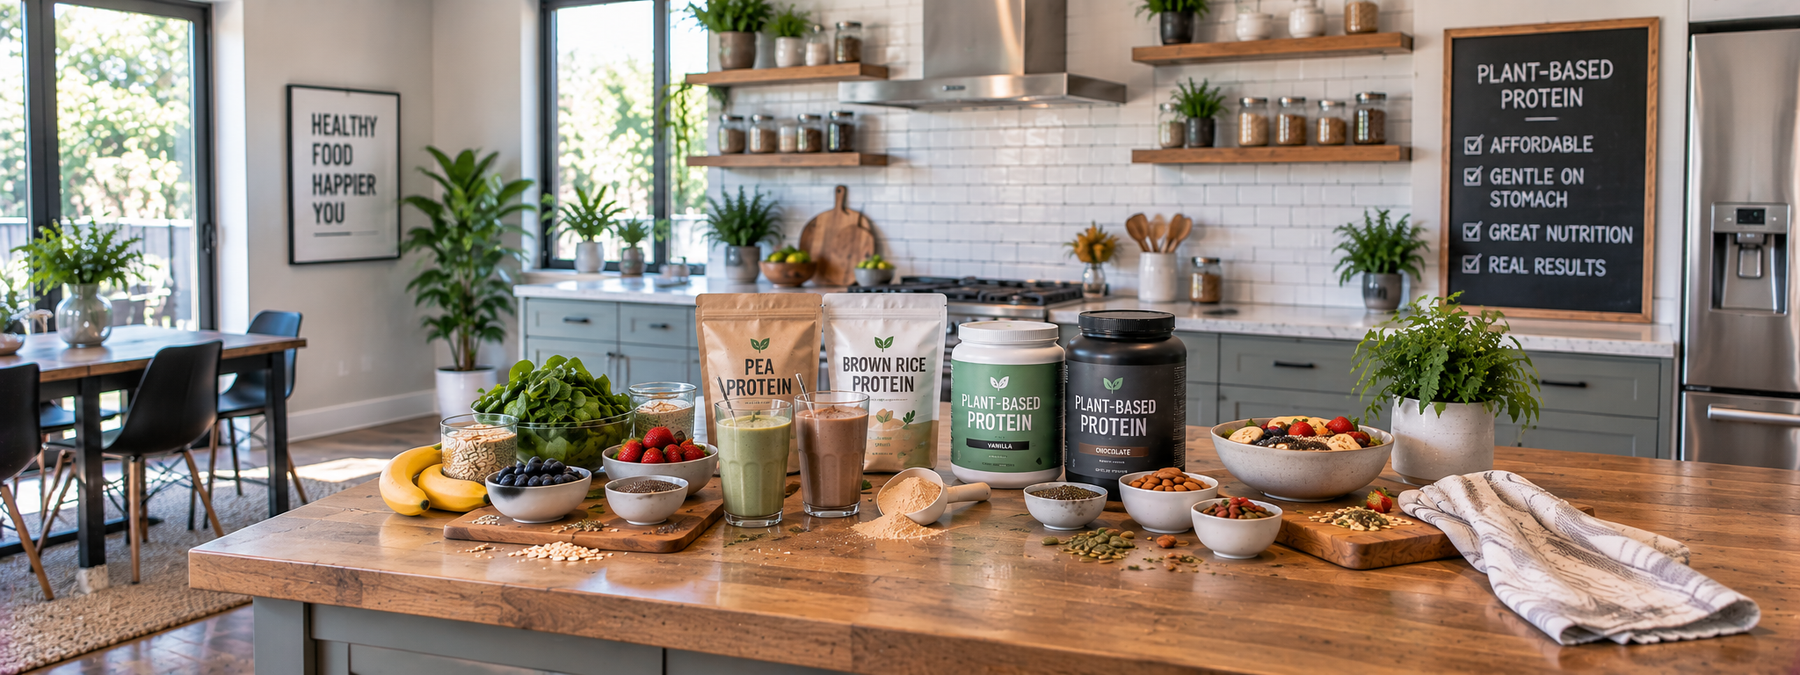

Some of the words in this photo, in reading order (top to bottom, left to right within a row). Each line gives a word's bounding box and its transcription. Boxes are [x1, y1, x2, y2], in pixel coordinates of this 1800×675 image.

[1477, 59, 1614, 85] PLANT-BASED
[1501, 86, 1583, 110] PROTEIN
[311, 112, 378, 138] HEALTHY
[312, 143, 353, 166] FOOD
[1489, 134, 1594, 154] AFFORDABLE
[312, 173, 377, 196] HAPPIER
[1489, 167, 1555, 186] GENTLE
[1560, 167, 1585, 186] ON
[1489, 189, 1569, 209] STOMACH
[312, 201, 345, 225] YOU
[1488, 223, 1541, 242] GREAT
[1545, 224, 1634, 244] NUTRITION
[1488, 255, 1530, 274] REAL
[1533, 256, 1607, 277] RESULTS
[744, 358, 775, 376] PEA
[842, 356, 892, 373] BROWN
[896, 357, 927, 373] RICE
[726, 377, 792, 397] PROTEIN
[852, 375, 915, 393] PROTEIN
[961, 393, 1041, 411] PLANT-BASED
[1075, 394, 1157, 415] PLANT-BASED
[967, 410, 1032, 432] PROTEIN
[1080, 414, 1147, 437] PROTEIN
[987, 442, 1013, 450] VANILLA
[1095, 447, 1131, 456] CHOCOLATE
